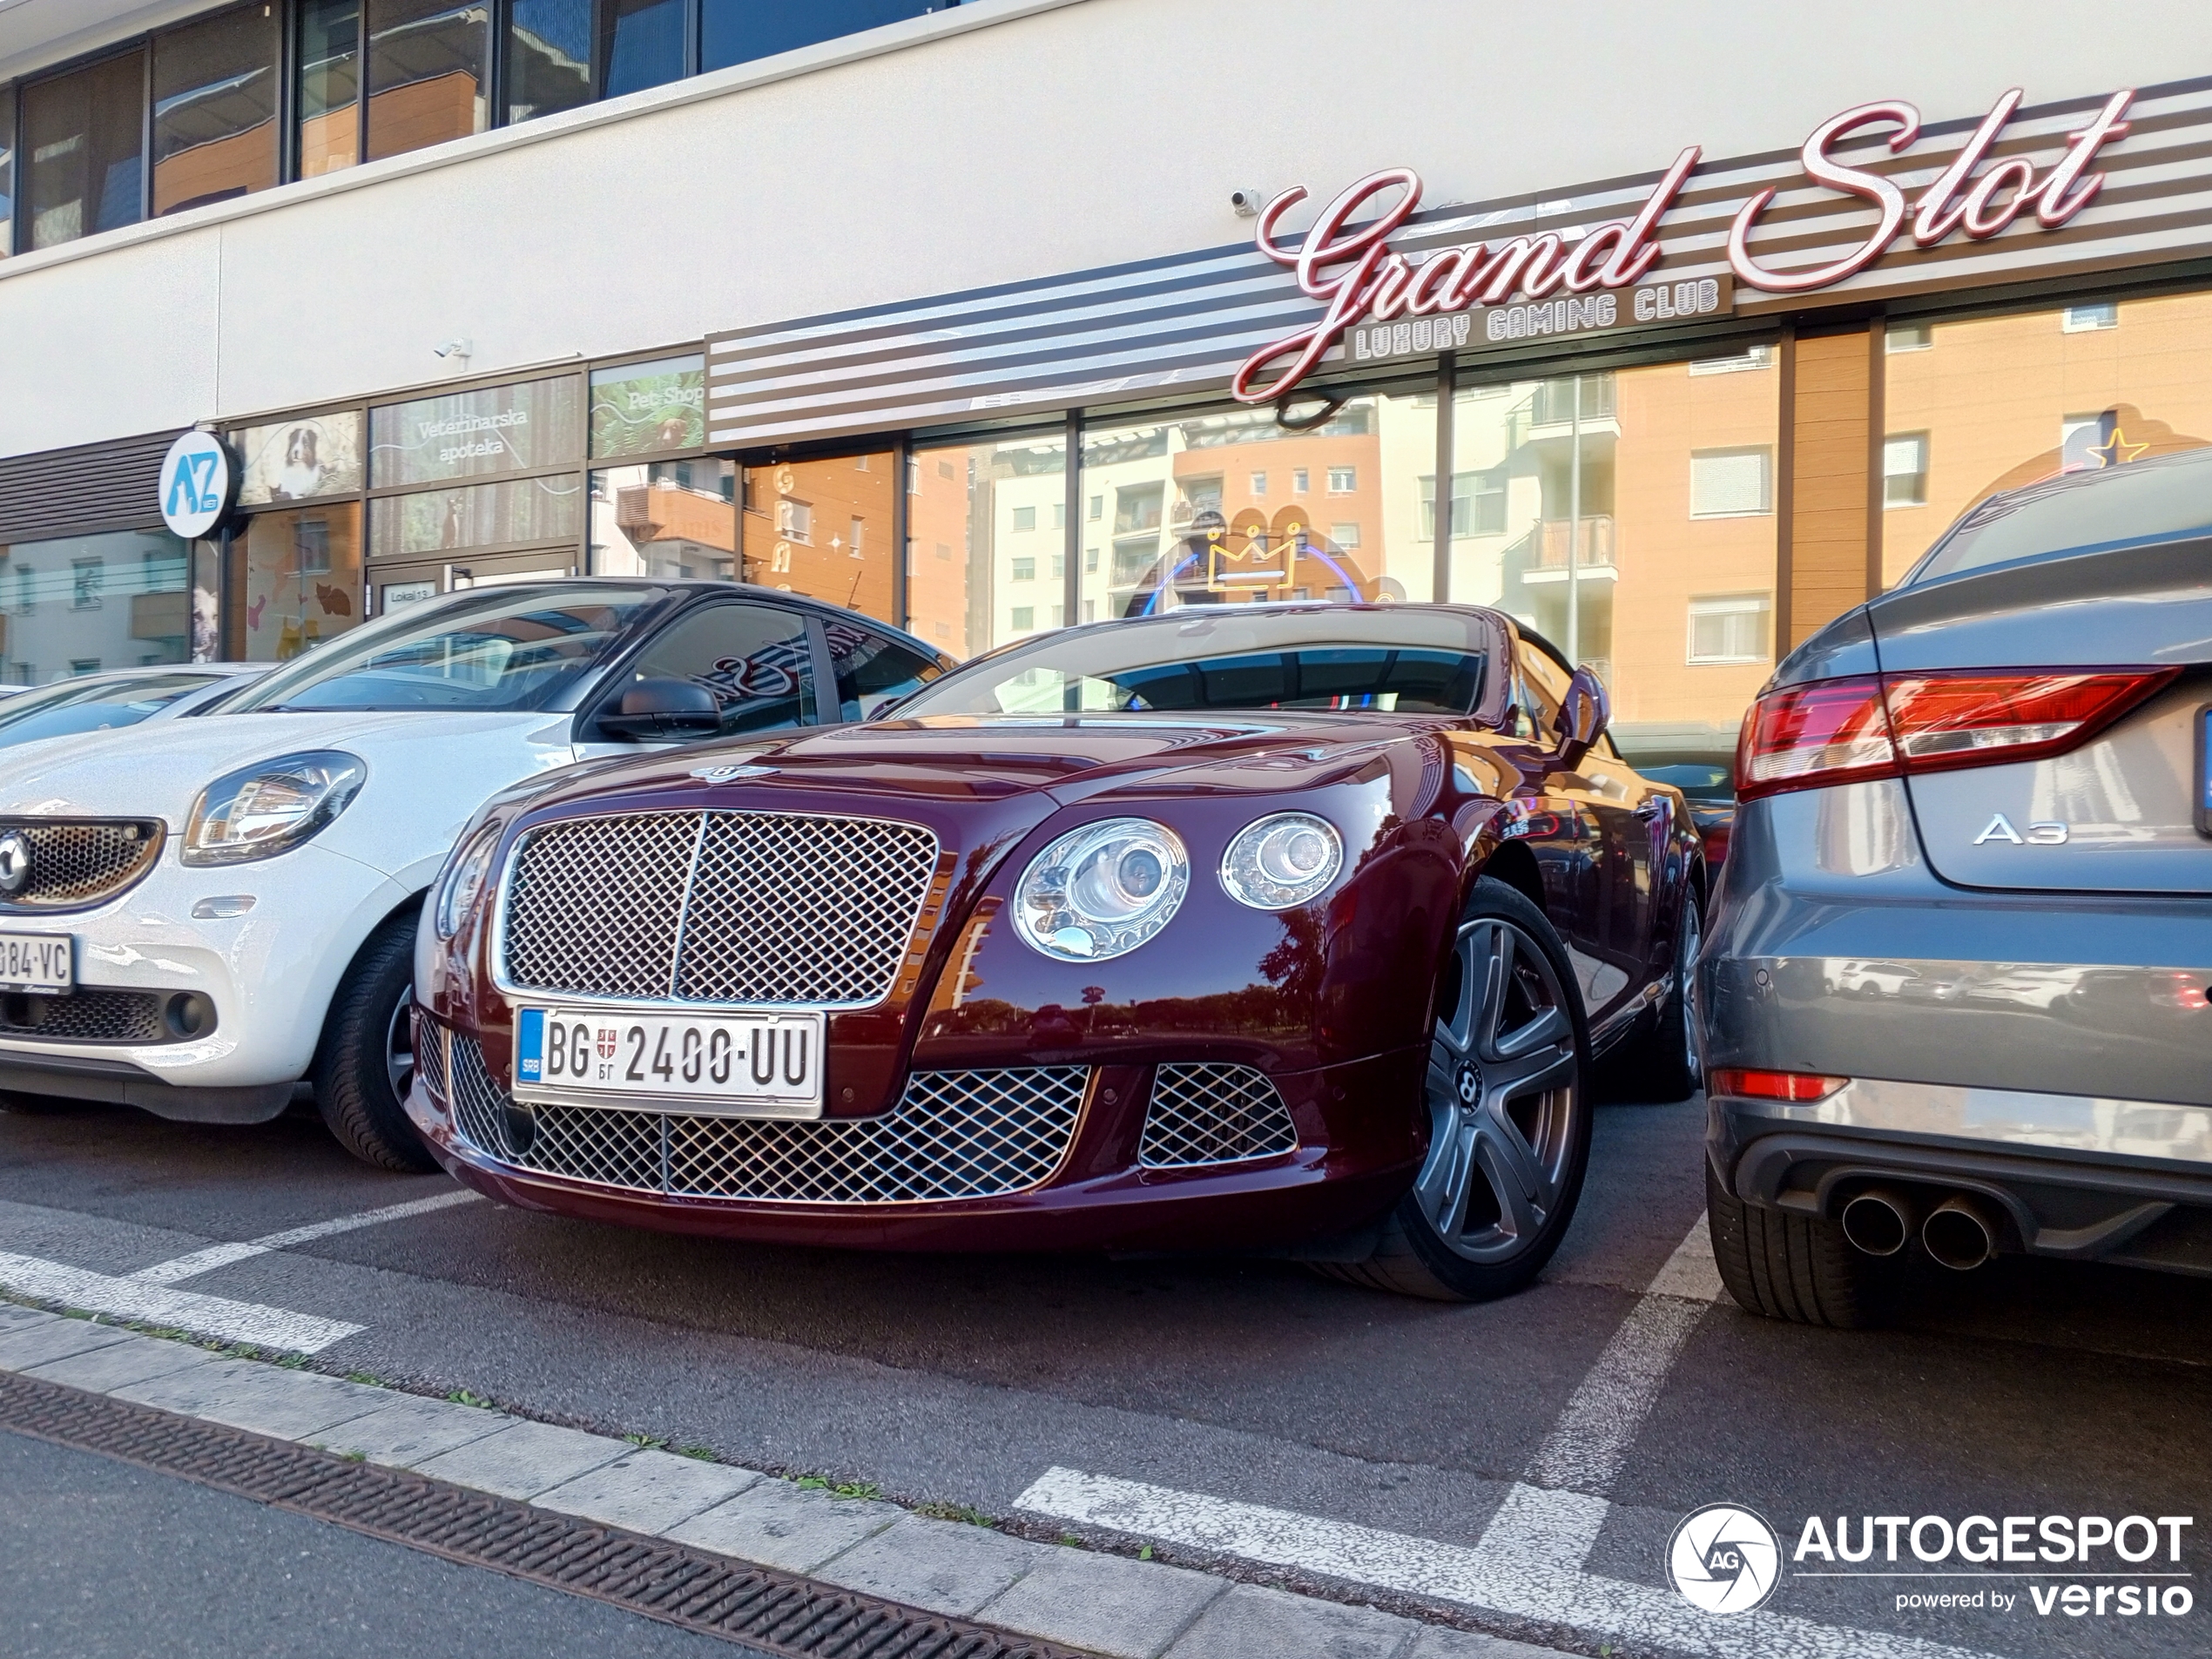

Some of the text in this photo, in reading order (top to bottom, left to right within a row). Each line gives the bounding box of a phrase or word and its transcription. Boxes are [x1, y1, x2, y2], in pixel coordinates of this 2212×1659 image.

[1231, 87, 2136, 404] Grand Slot
[1355, 279, 1719, 360] LUXURY GAMING CLUB
[628, 385, 705, 410] Pet Shop
[418, 408, 528, 439] Veterinarska
[440, 437, 504, 464] apoteka
[772, 462, 794, 592] GRA
[391, 590, 415, 603] Lokal
[1973, 813, 2068, 845] A3
[523, 1058, 539, 1073] SRB
[548, 1022, 807, 1087] BG 2400-UU
